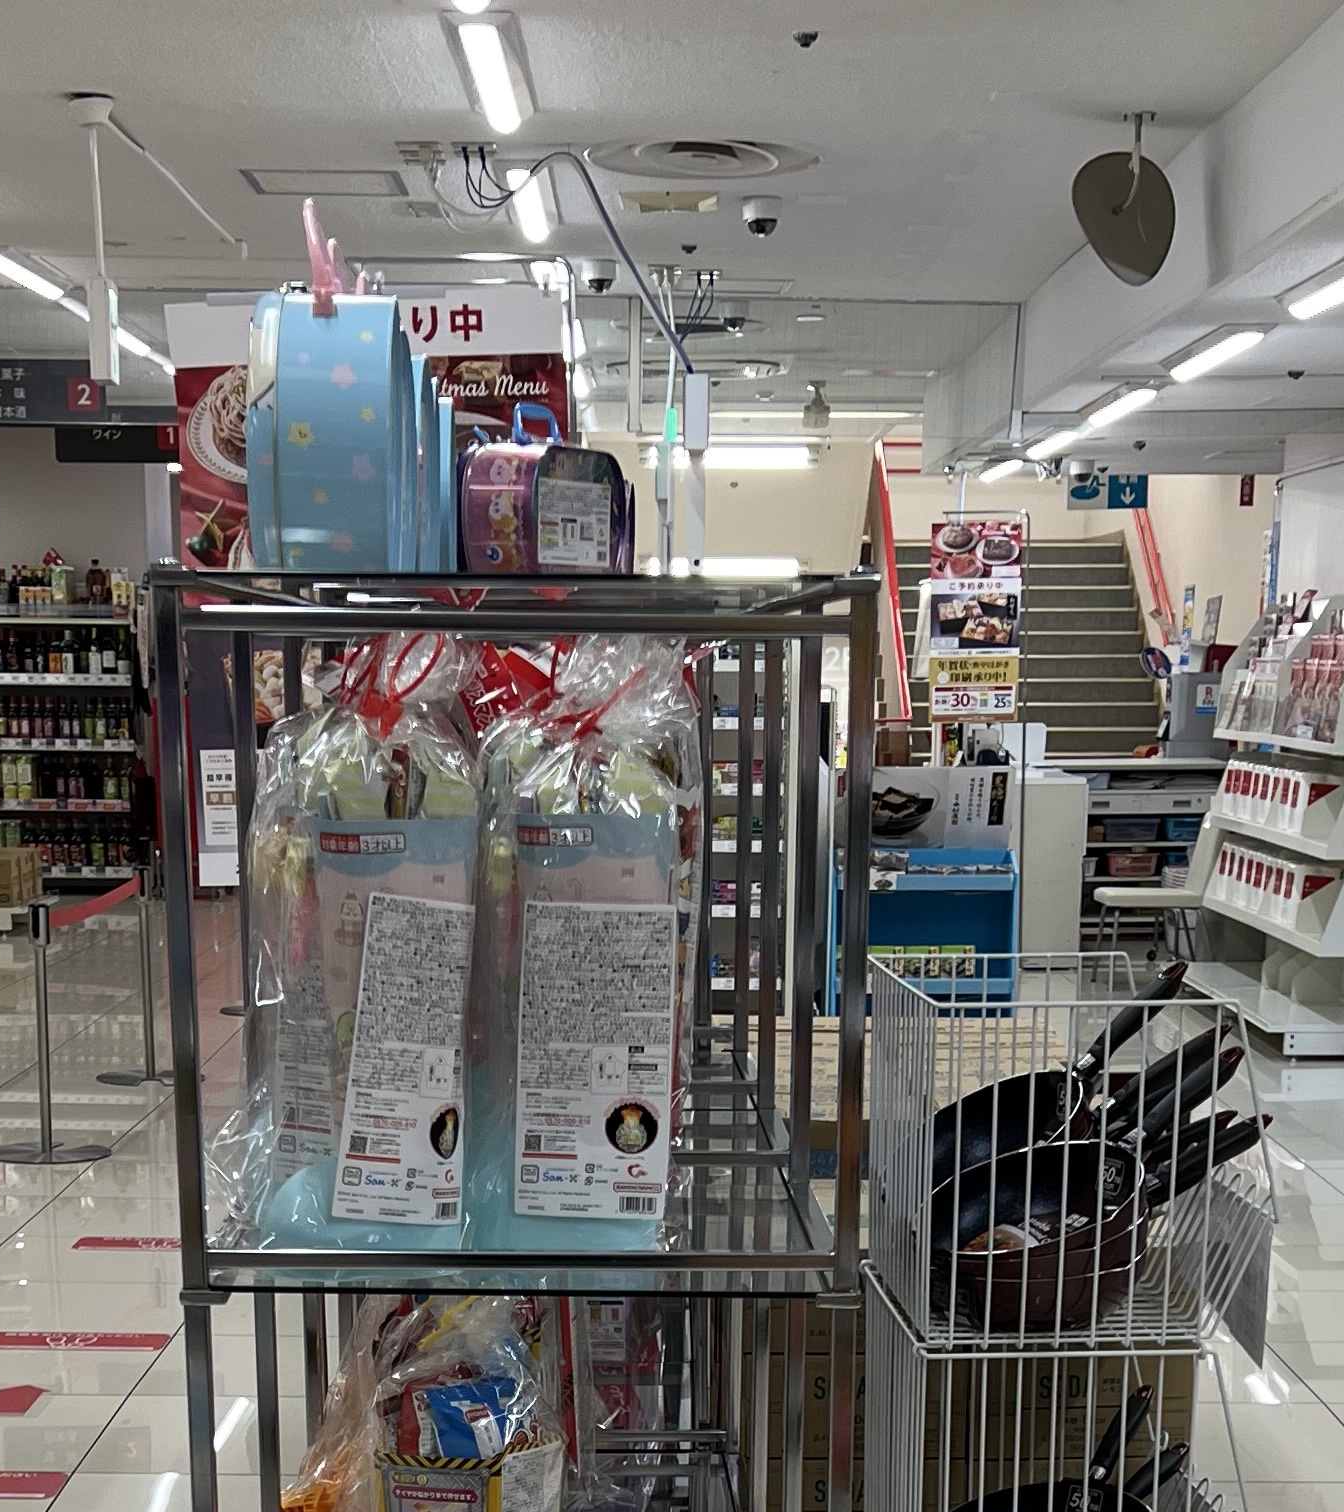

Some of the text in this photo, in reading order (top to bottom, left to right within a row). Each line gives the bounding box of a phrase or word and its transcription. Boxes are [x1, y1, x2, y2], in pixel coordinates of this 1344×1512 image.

[493, 374, 550, 397] Menu
[76, 384, 92, 406] 2
[92, 429, 122, 441] ワイン
[165, 426, 175, 446] 1
[951, 693, 971, 708] 30
[994, 696, 1007, 709] 25
[361, 838, 403, 853] 3才以上
[542, 1171, 578, 1184] San-X
